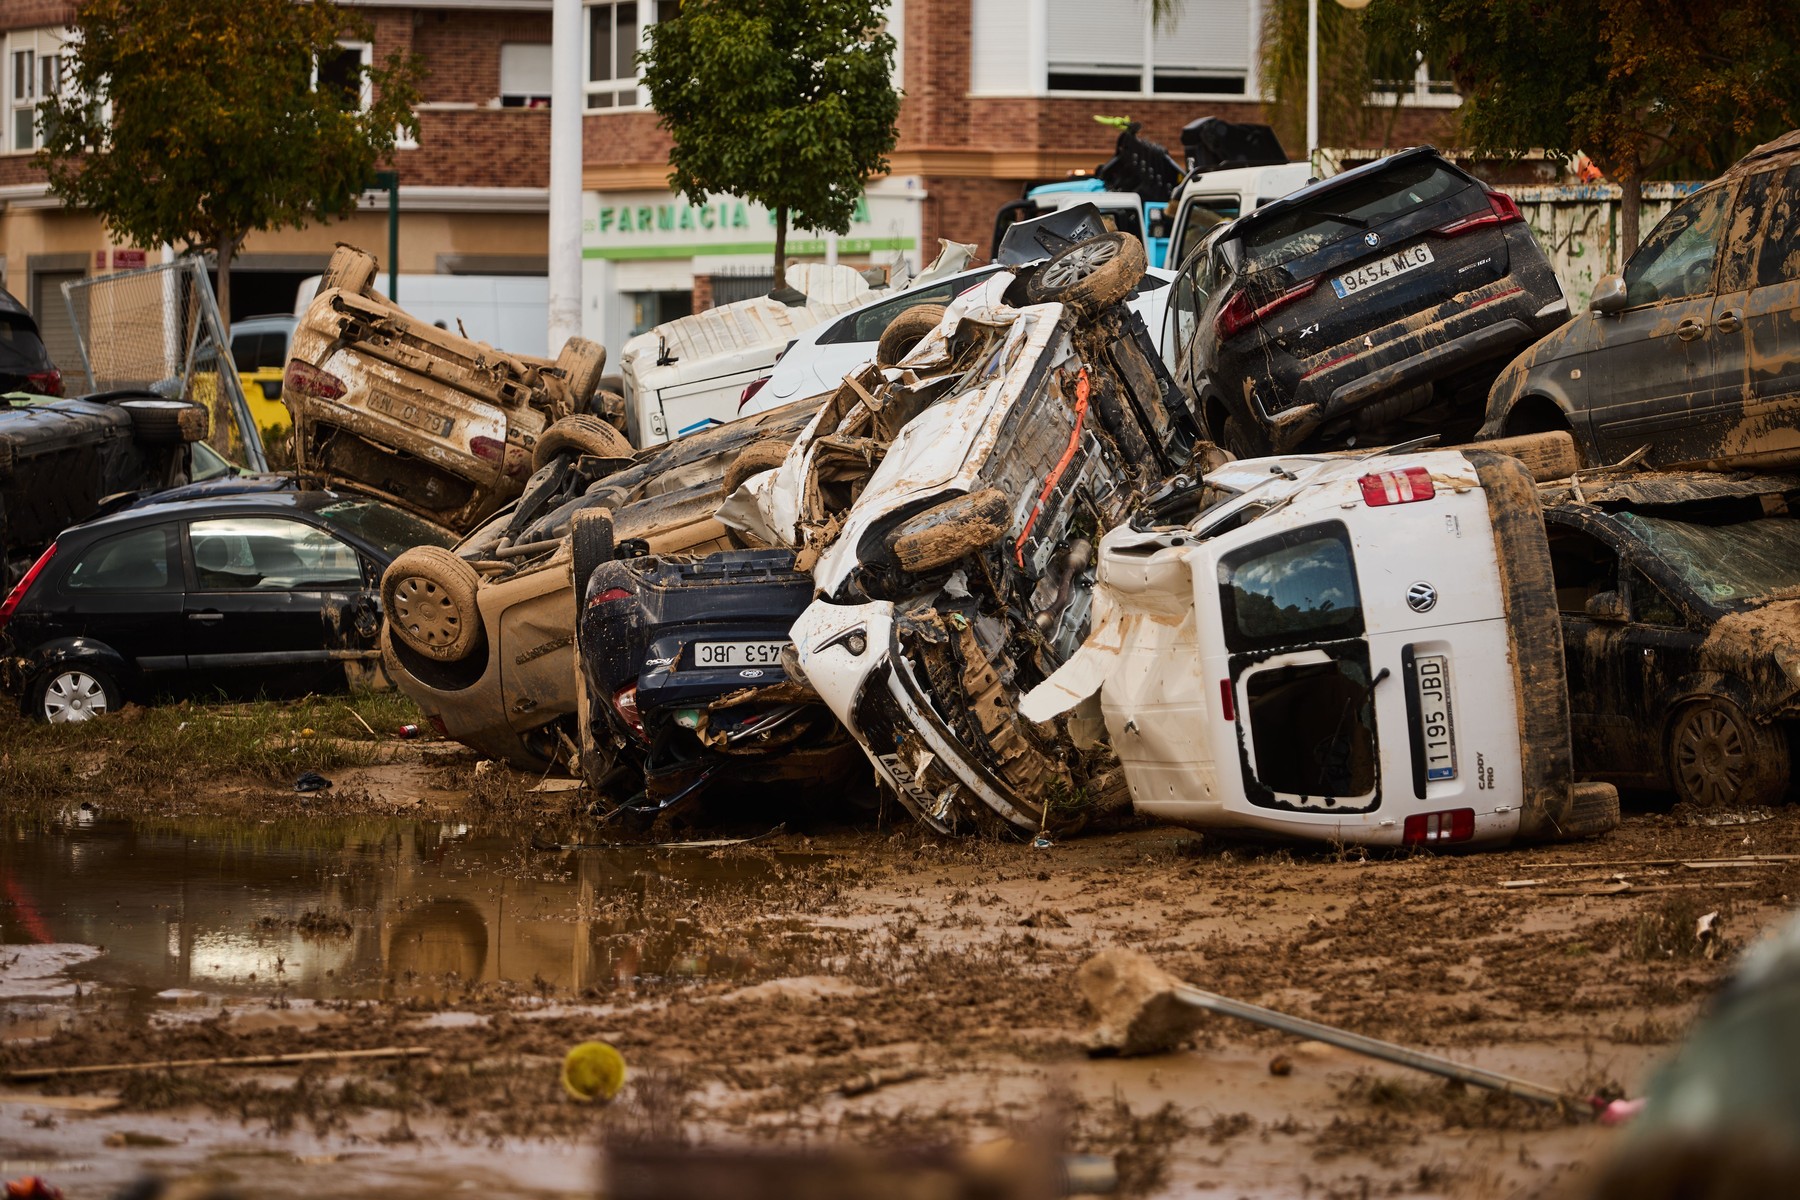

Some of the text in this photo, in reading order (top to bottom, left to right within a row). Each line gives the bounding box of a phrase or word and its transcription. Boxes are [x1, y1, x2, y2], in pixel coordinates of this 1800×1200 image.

[599, 202, 748, 231] FARMACIA
[1345, 248, 1427, 290] 9454 MLG
[1299, 323, 1319, 338] X1
[701, 643, 791, 662] 453 JBC
[1421, 662, 1449, 762] 1195 JBD
[1477, 752, 1486, 790] CADDY
[1487, 767, 1495, 790] PRO
[909, 787, 936, 810] 70
